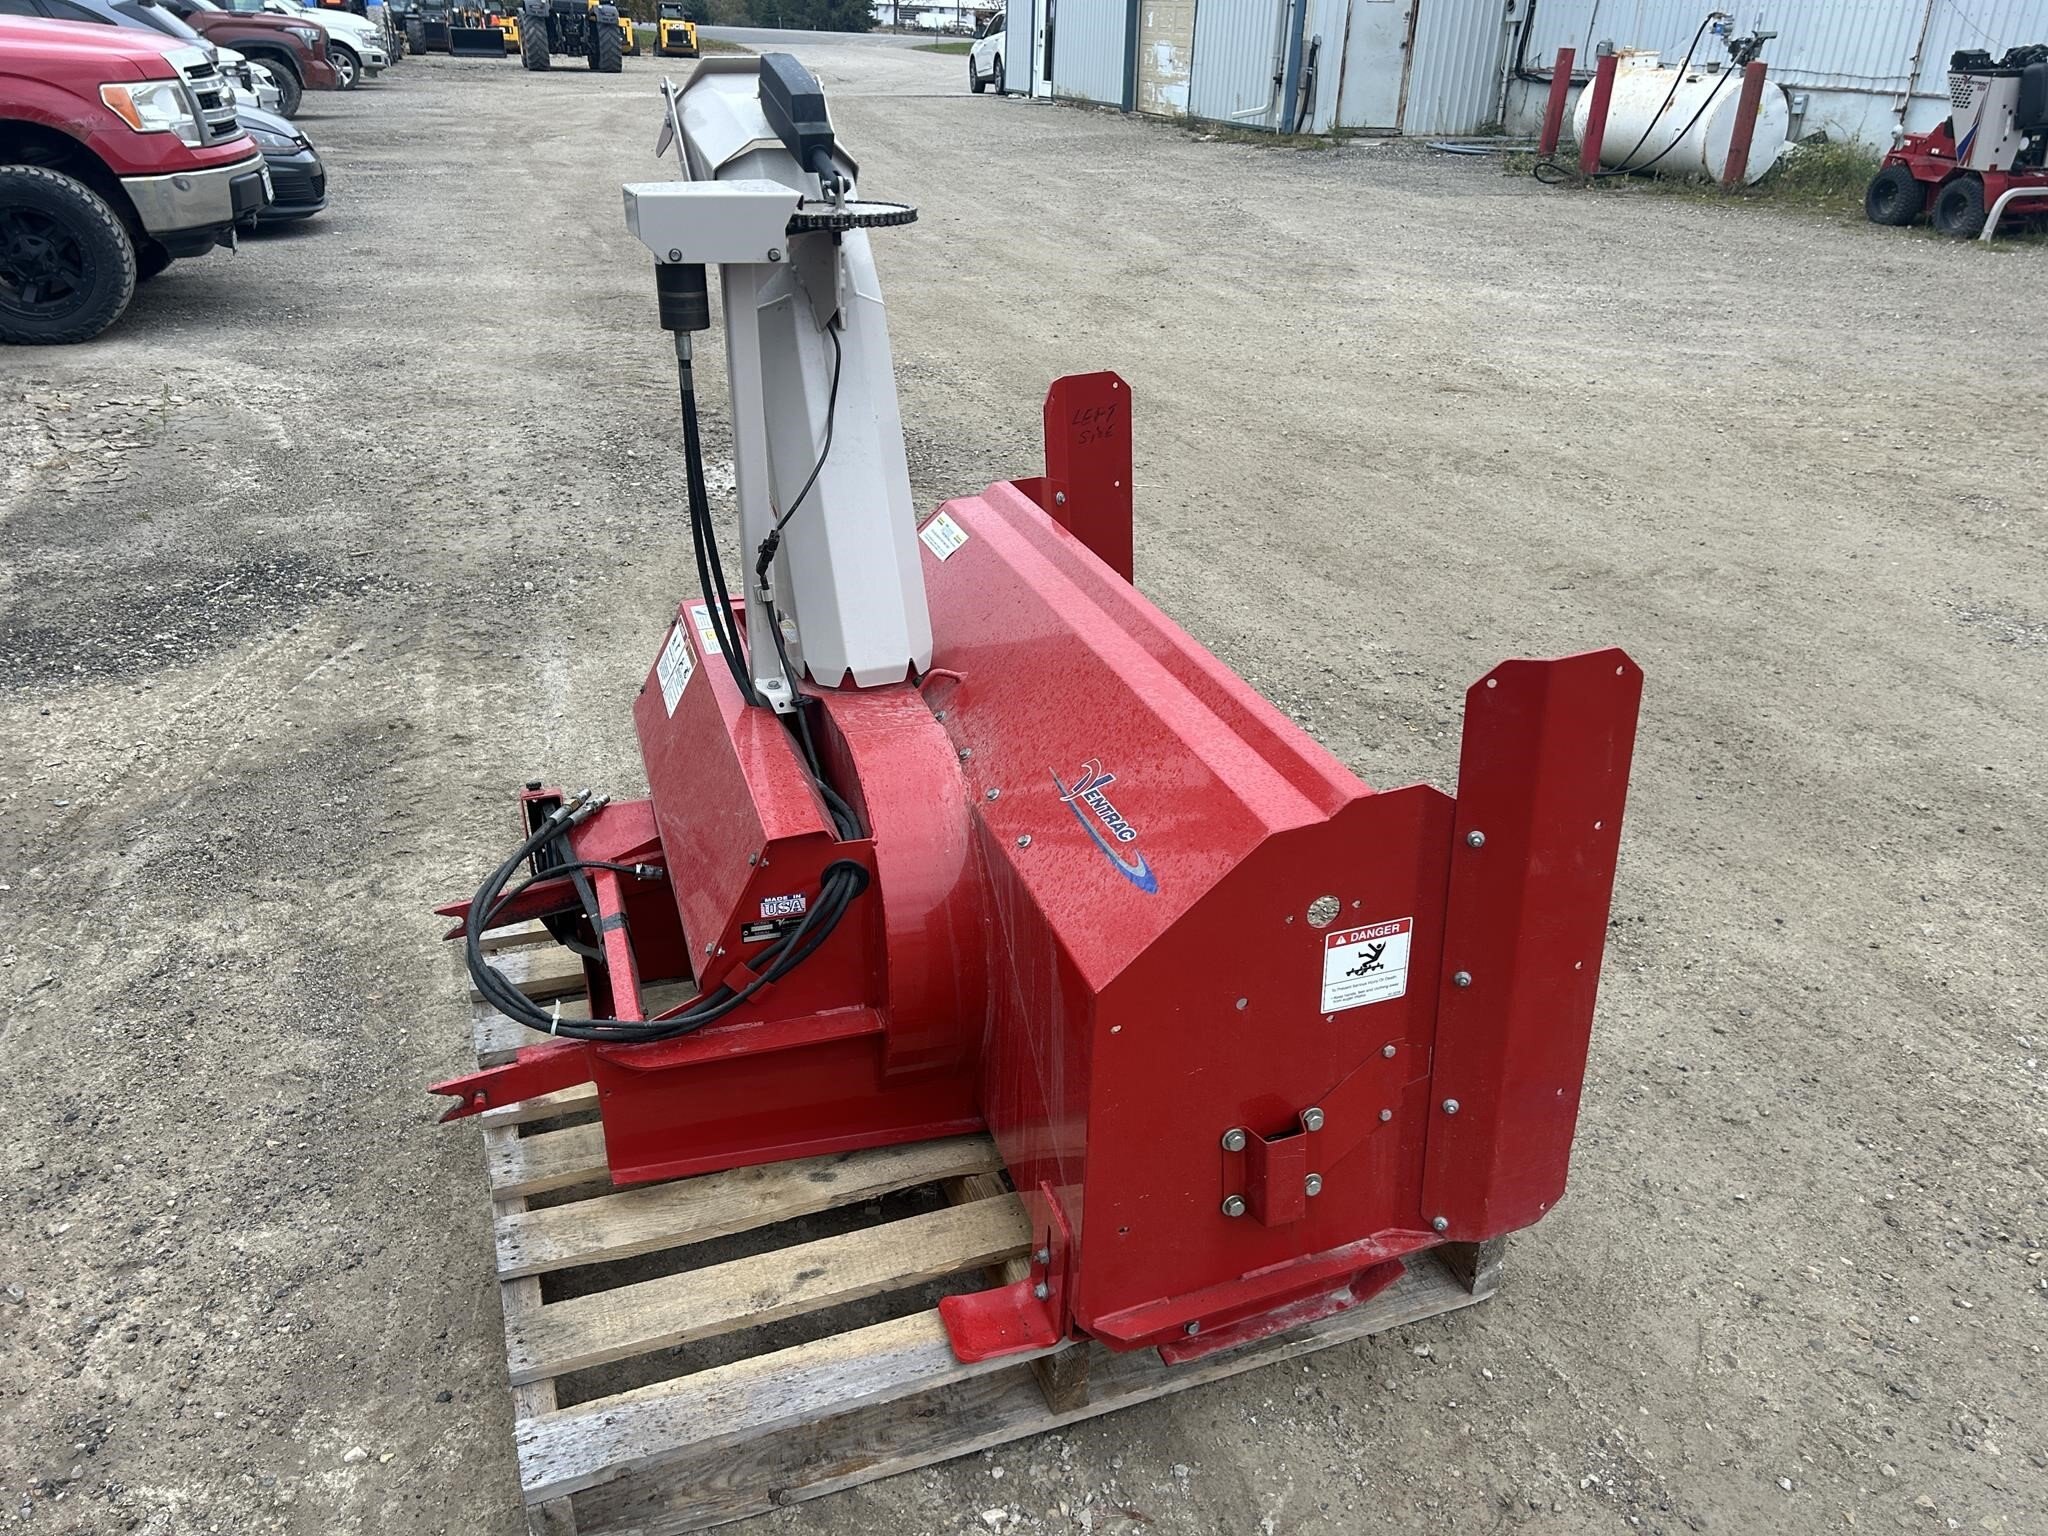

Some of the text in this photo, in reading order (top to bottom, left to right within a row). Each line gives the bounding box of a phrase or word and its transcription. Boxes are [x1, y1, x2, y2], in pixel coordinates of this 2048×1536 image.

[1060, 758, 1137, 842] VENTRAC
[763, 899, 805, 916] USA
[1350, 923, 1400, 942] DANGER
